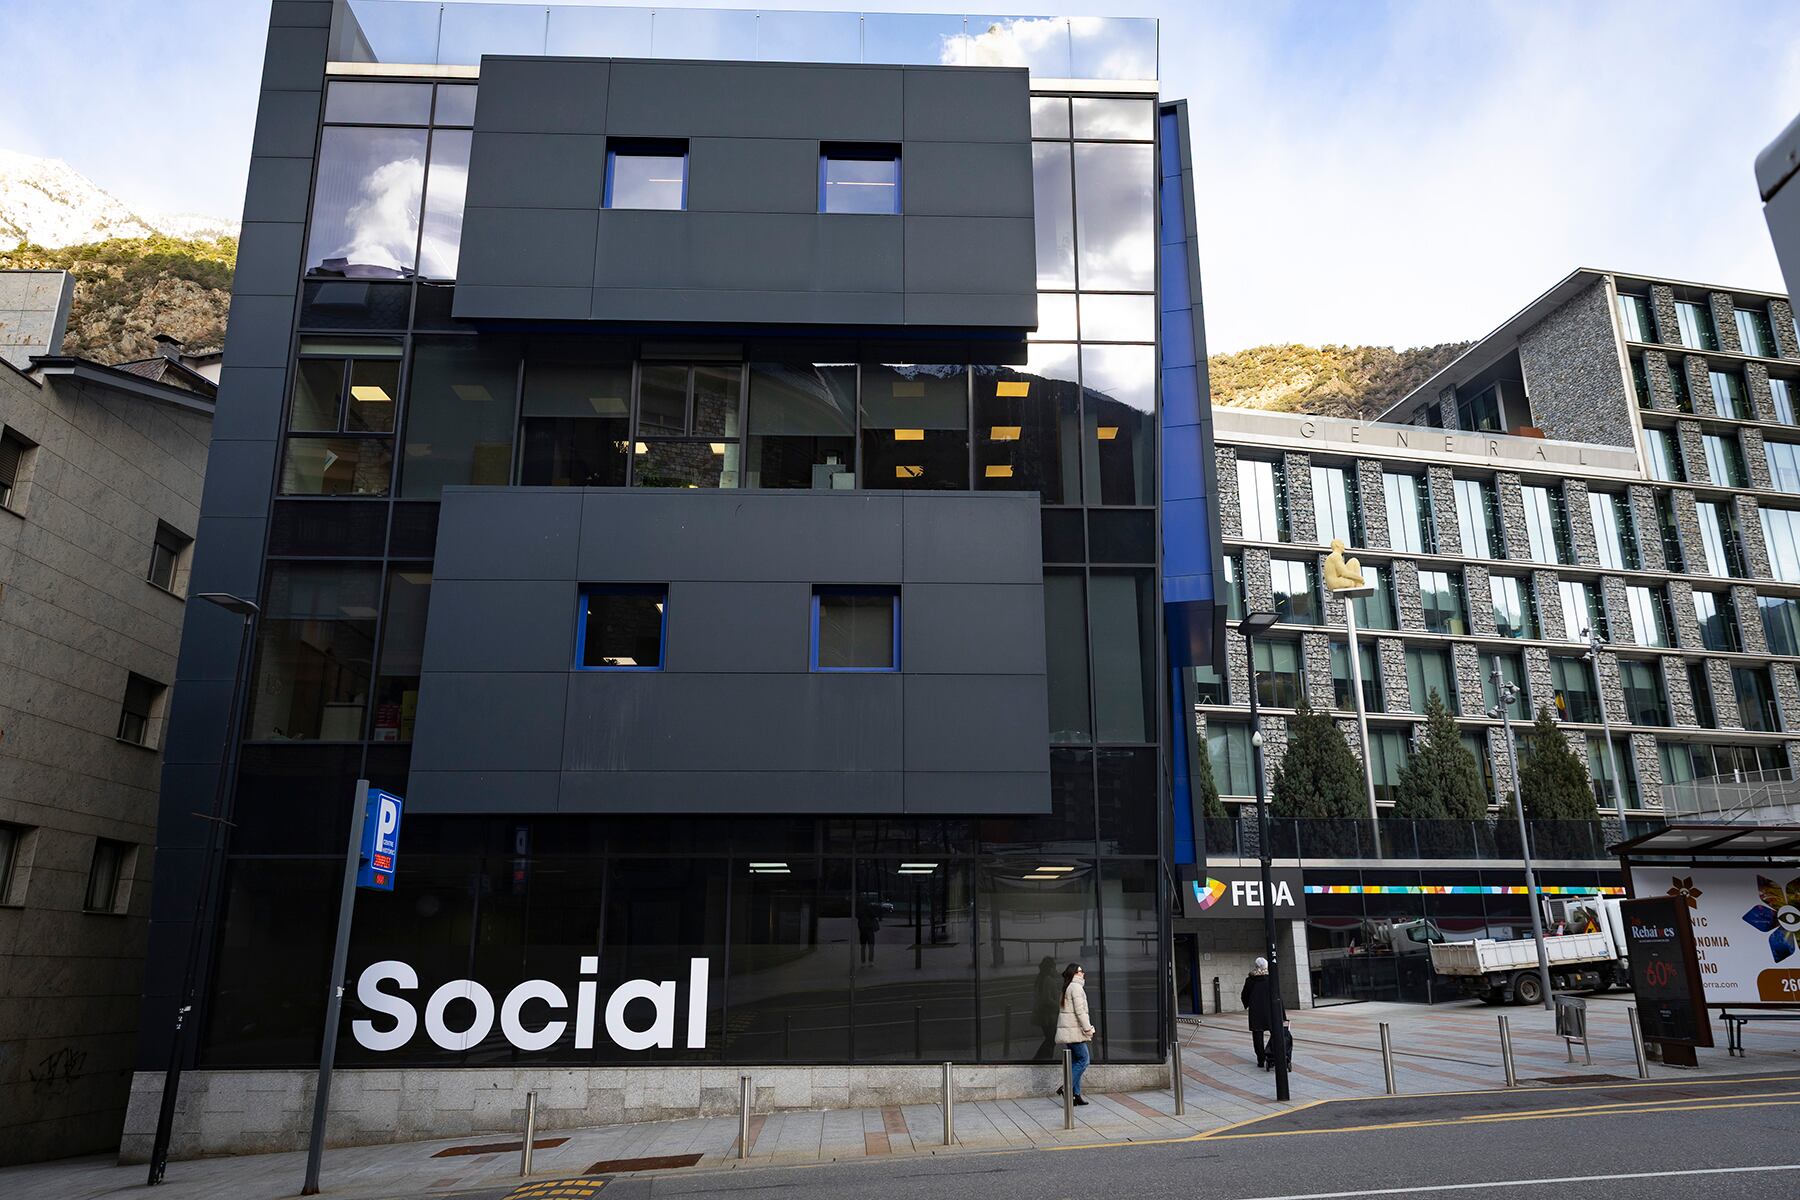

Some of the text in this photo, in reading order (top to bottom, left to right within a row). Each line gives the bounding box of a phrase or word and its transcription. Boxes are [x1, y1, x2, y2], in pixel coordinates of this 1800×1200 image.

[1300, 421, 1587, 465] GENERAL
[376, 798, 397, 852] P
[1231, 880, 1295, 906] FEDA
[352, 956, 709, 1050] Social
